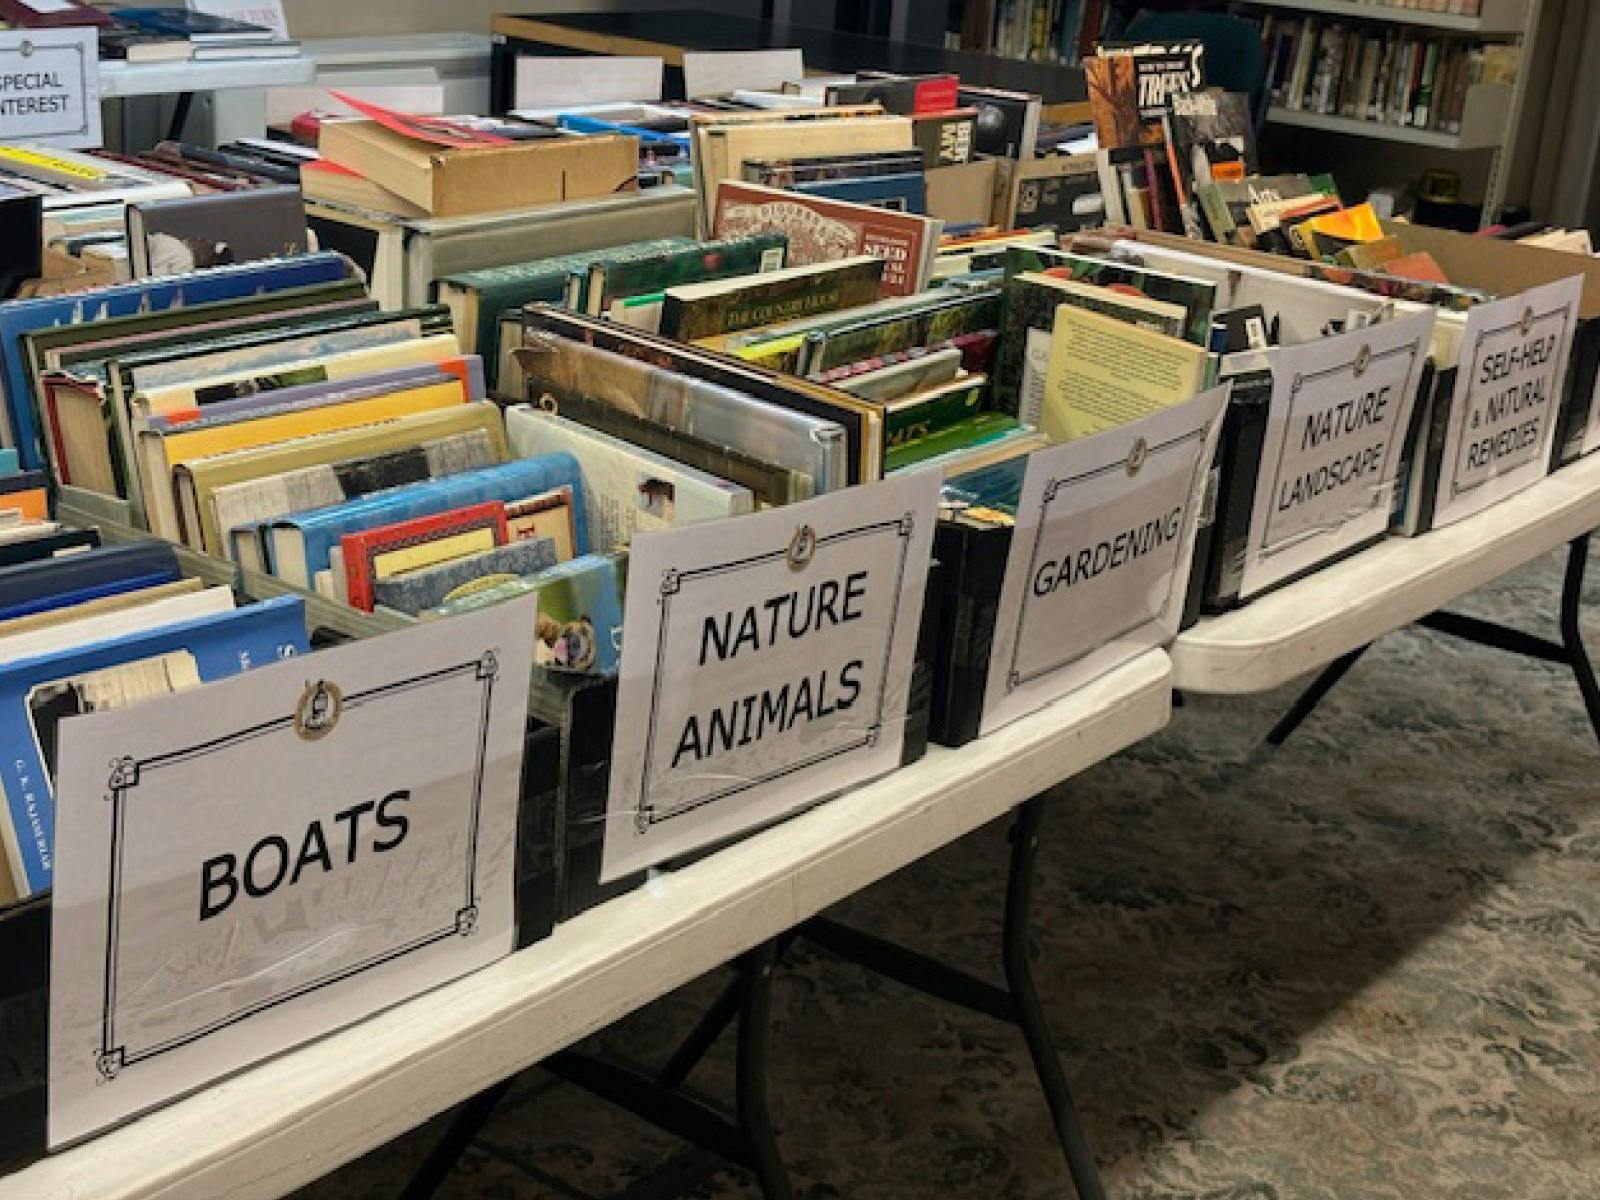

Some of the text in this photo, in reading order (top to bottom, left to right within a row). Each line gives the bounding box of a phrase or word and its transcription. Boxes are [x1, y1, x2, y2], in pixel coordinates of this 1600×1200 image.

[0, 72, 64, 91] PECIAL
[0, 94, 71, 115] NTEREST
[1480, 334, 1555, 384] SELF-HELP
[1301, 384, 1391, 452] NATURE
[1471, 375, 1545, 429] & NATURAL
[1278, 440, 1384, 514] LANDSCAPE
[1467, 416, 1540, 470] REMEDIES
[1034, 506, 1181, 597] GARDENING
[698, 571, 868, 667] NATURE
[670, 660, 863, 768] ANIMALS
[199, 791, 410, 922] BOATS
